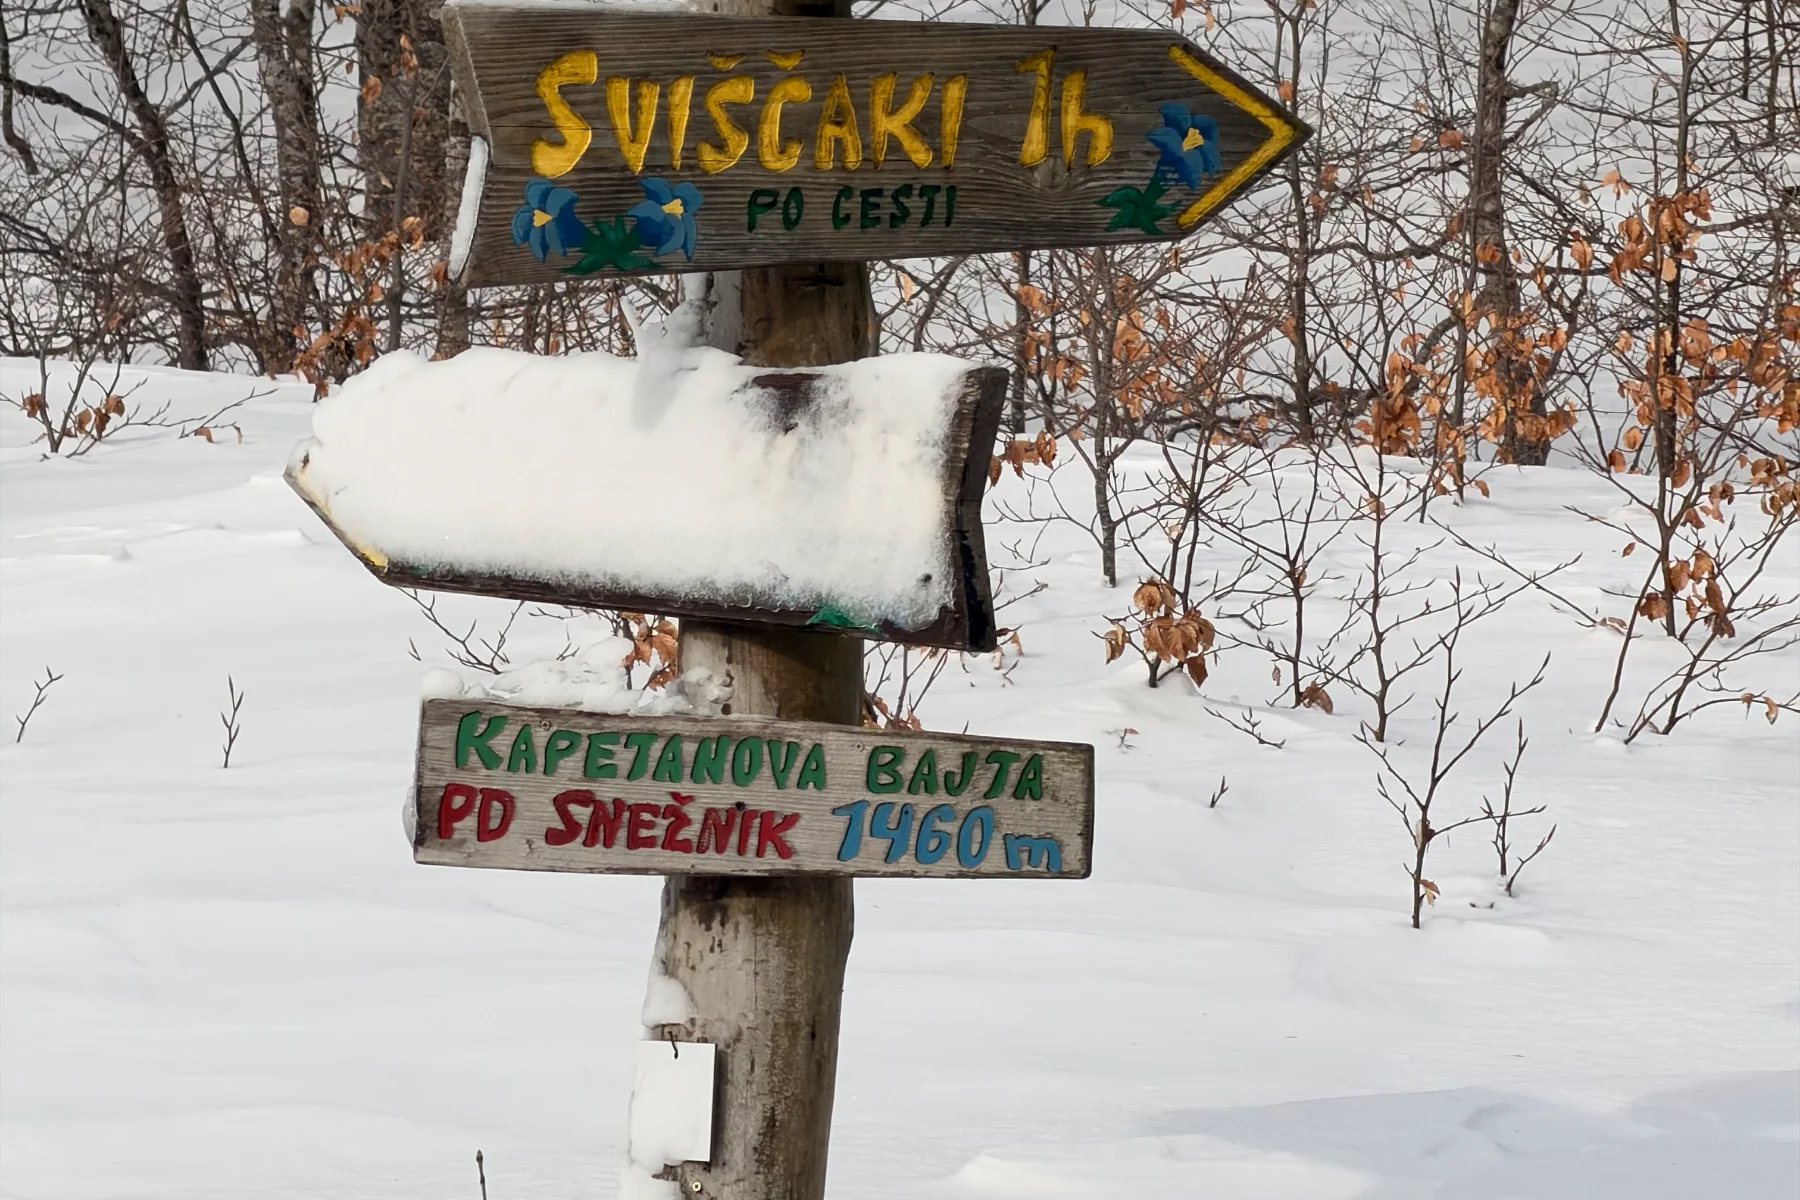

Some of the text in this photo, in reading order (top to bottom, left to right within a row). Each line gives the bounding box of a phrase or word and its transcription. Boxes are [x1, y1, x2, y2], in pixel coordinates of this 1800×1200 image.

[531, 45, 1114, 178] SVIŠČAKI 1h
[747, 184, 957, 233] PO CESTI
[455, 711, 1044, 800] KAPETANOVA BAJTA
[438, 783, 1063, 873] PD SNEŽNIK 1460 m
